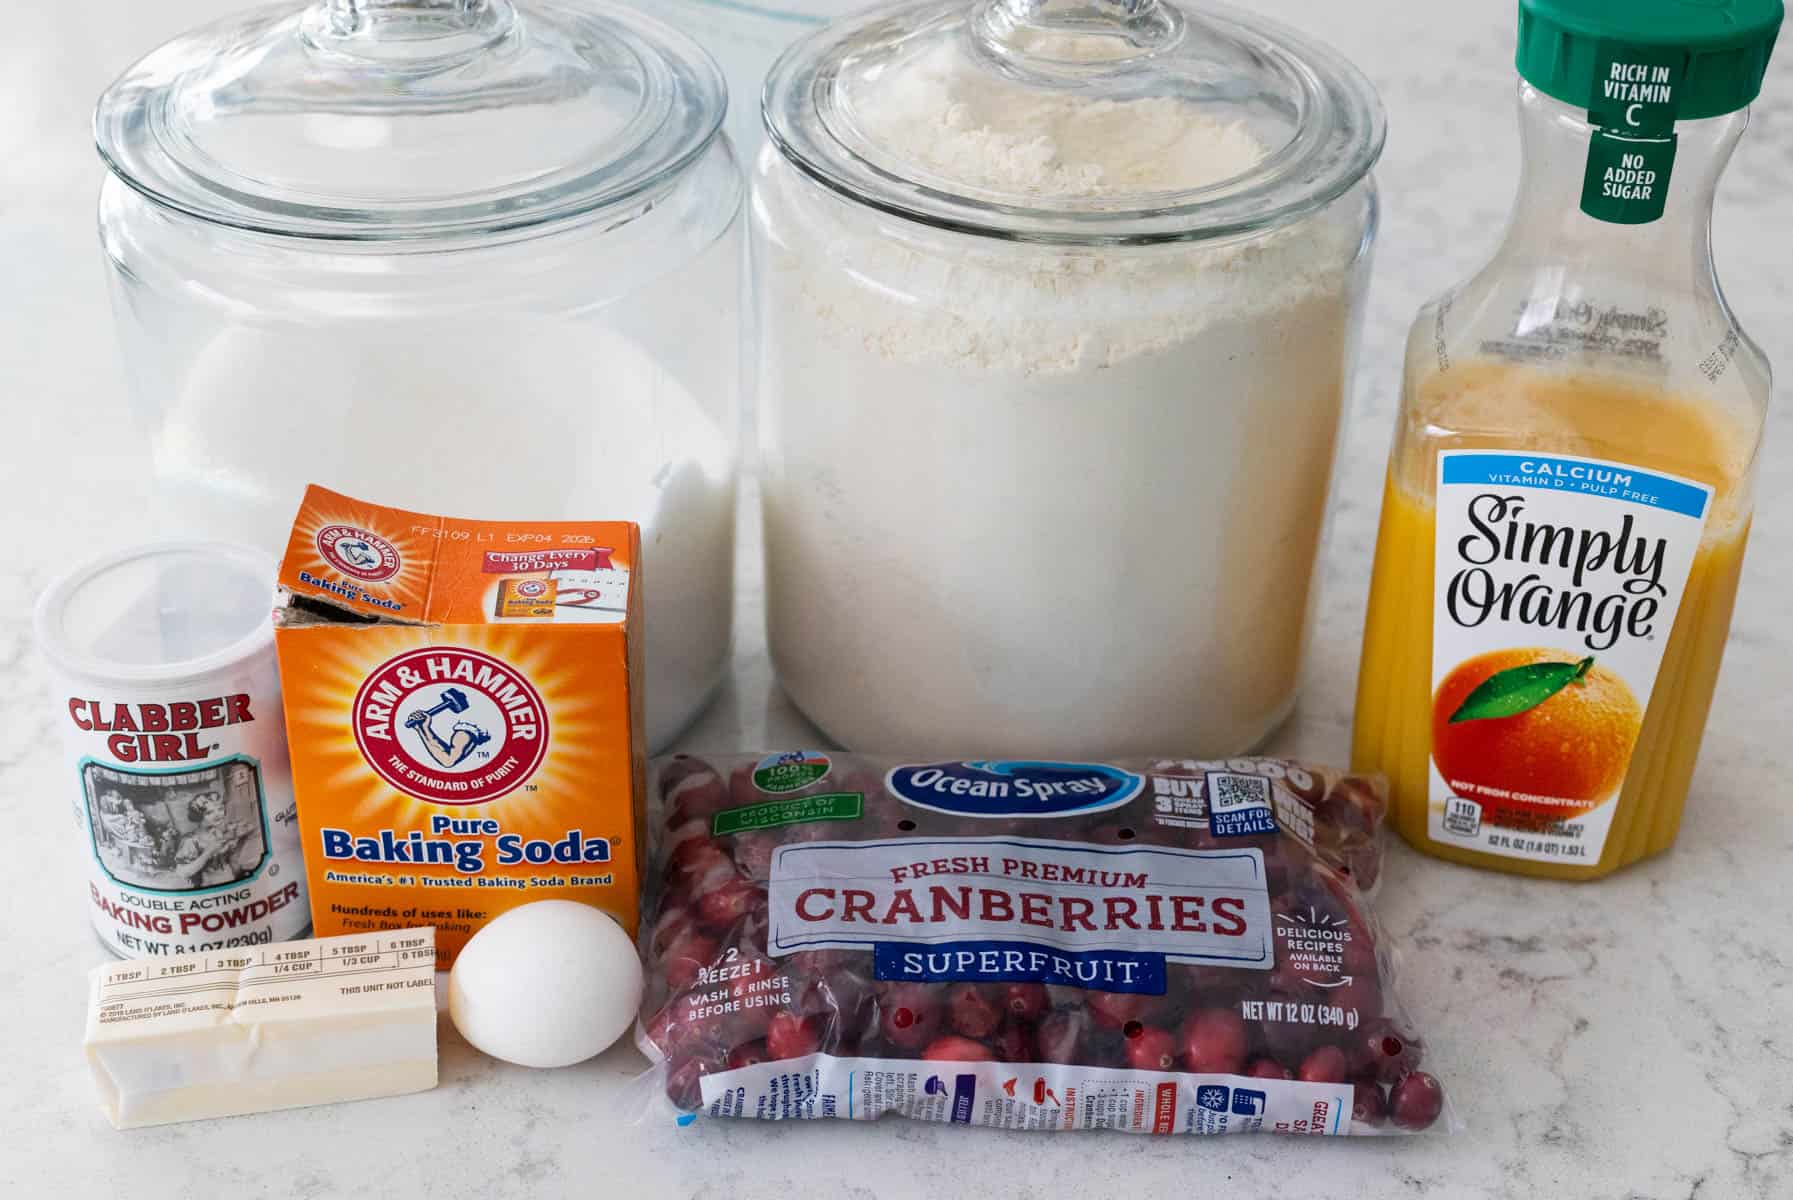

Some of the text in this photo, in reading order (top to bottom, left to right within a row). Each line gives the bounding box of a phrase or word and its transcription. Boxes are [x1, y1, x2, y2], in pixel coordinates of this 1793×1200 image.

[1611, 62, 1670, 83] RICH IN
[1604, 80, 1671, 103] VITAMIN
[1626, 103, 1643, 126] C
[1622, 154, 1644, 169] NO
[1603, 167, 1656, 185] ADDED
[1602, 182, 1653, 200] SUGAR
[1520, 461, 1632, 486] CALCIUM
[1489, 473, 1658, 505] VITAMIN D PULP FREE
[322, 529, 341, 547] ARM
[1457, 493, 1667, 597] Simply
[488, 550, 587, 563] Change Every
[511, 560, 569, 571] 30 Days
[300, 571, 401, 611] Baking Soda
[1447, 567, 1658, 650] Orange
[366, 656, 536, 741] ARM & HAMMER
[69, 694, 254, 732] CLABBER
[107, 732, 211, 762] GIRL
[388, 755, 520, 791] THE STANDARD OF PURITY
[911, 769, 1106, 800] Ocean Spray
[1153, 777, 1204, 797] BUY
[1451, 779, 1595, 808] NOT FROM CONCENTRATE
[1155, 796, 1173, 812] 3
[1454, 801, 1475, 816] 110
[432, 815, 499, 835] Pure
[1216, 813, 1246, 825] SCAN
[1217, 819, 1275, 834] DETAILS
[321, 828, 611, 873] Baking Soda
[1513, 839, 1524, 849] OZ
[326, 871, 612, 890] America's #1 Trusted Baking Soda Brand
[891, 857, 1148, 888] FRESH PREMIUM
[89, 880, 299, 935] BAKING POWDER
[120, 889, 251, 911] DOUBLE ACTING
[331, 904, 488, 919] Hundreds of uses like:
[795, 886, 1247, 936] CRANBERRIES
[342, 918, 375, 929] Fresh
[117, 929, 142, 950] NET
[145, 938, 169, 956] WT
[401, 939, 424, 948] TBSP
[1277, 927, 1352, 942] DELICIOUS
[342, 945, 367, 954] TBSP
[726, 947, 738, 962] 2
[1288, 940, 1344, 953] RECIPES
[227, 958, 252, 968] TBSP
[275, 951, 310, 961] 4 TBSP
[360, 955, 380, 965] CUP
[1290, 953, 1343, 963] AVAILABLE
[117, 971, 142, 981] TBSP
[161, 964, 196, 976] 2 TBSP
[274, 963, 313, 974] 1/4 CUP
[904, 951, 1138, 983] SUPERFRUIT
[1294, 963, 1340, 972] ON BACK
[340, 986, 361, 995] THIS
[363, 983, 383, 993] UNIT
[386, 981, 404, 990] NOT
[689, 976, 789, 1006] WASH & RINSE
[689, 992, 791, 1021] BEFORE USING
[1242, 1001, 1359, 1030] NET WT 12 OZ (340 g)
